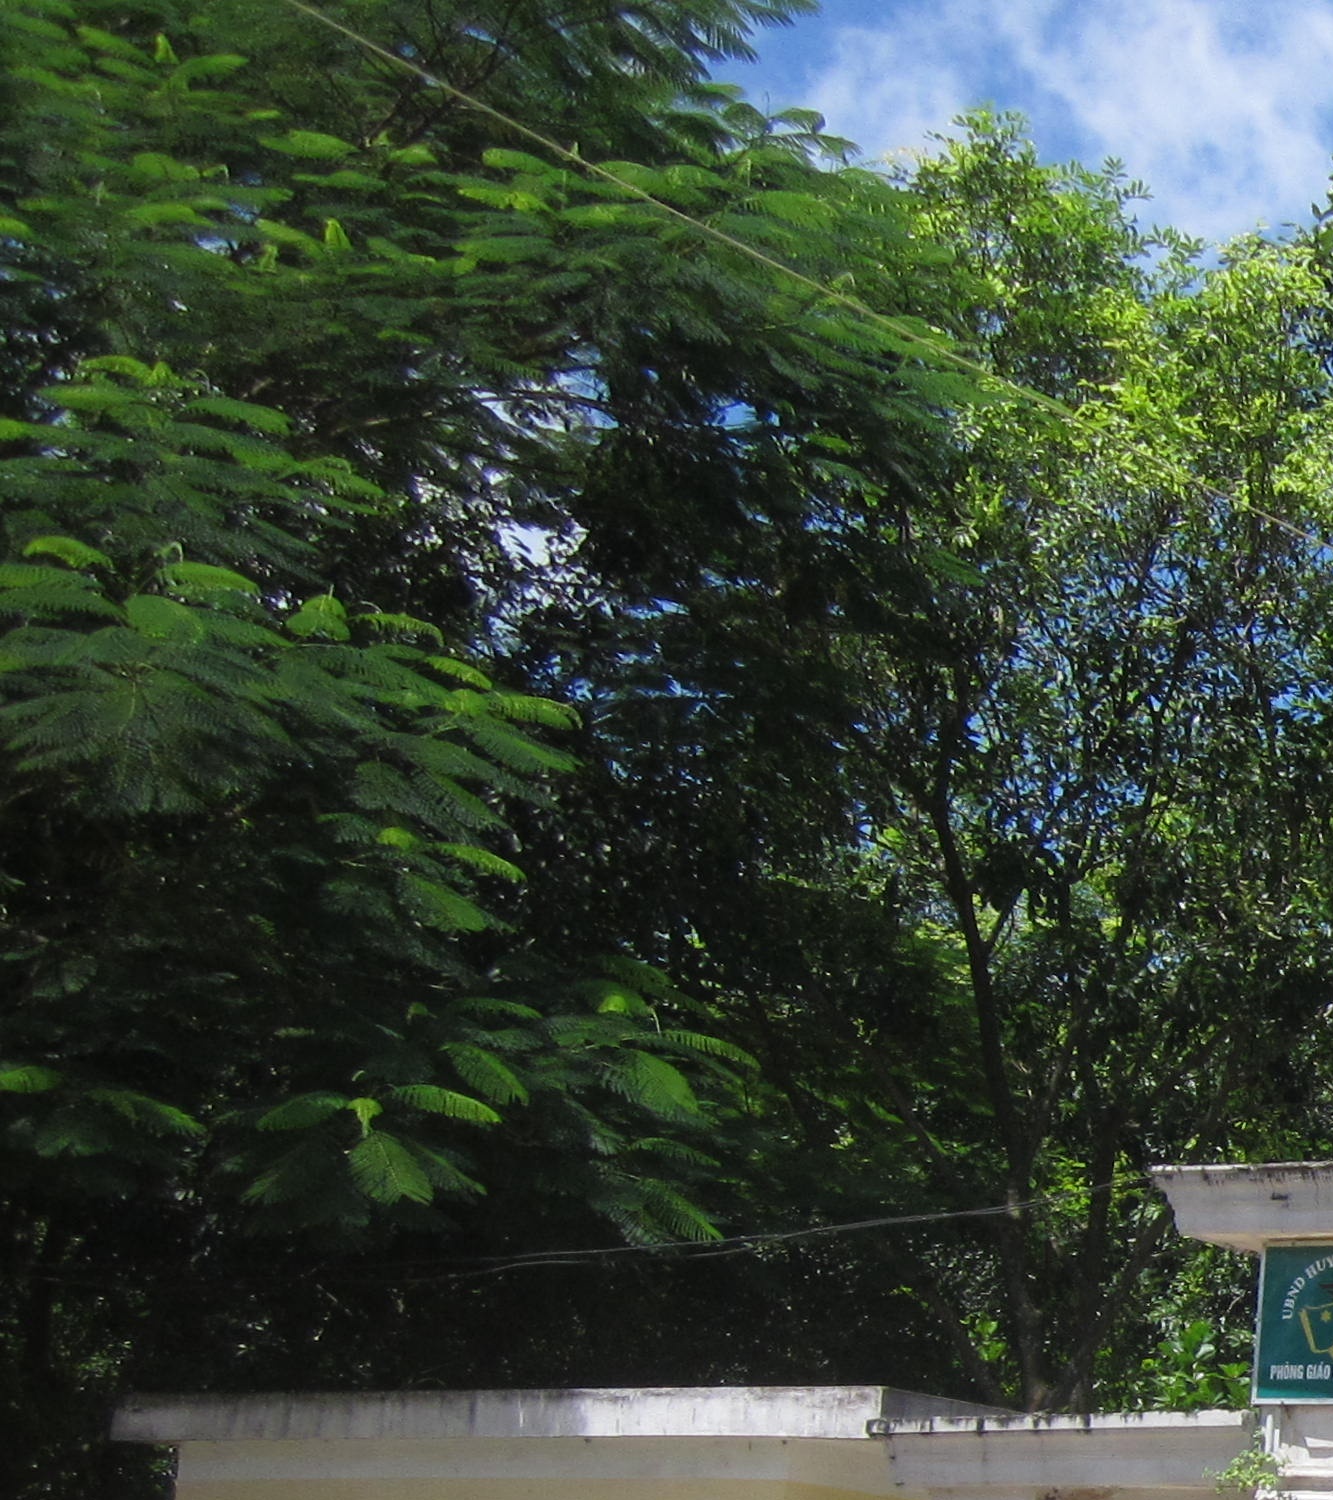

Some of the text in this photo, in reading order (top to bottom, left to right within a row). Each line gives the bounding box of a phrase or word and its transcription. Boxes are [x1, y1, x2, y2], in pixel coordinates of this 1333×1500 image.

[1282, 1277, 1305, 1320] UBND
[1269, 1361, 1303, 1380] PHÒNG
[1306, 1361, 1330, 1380] GIÁO
